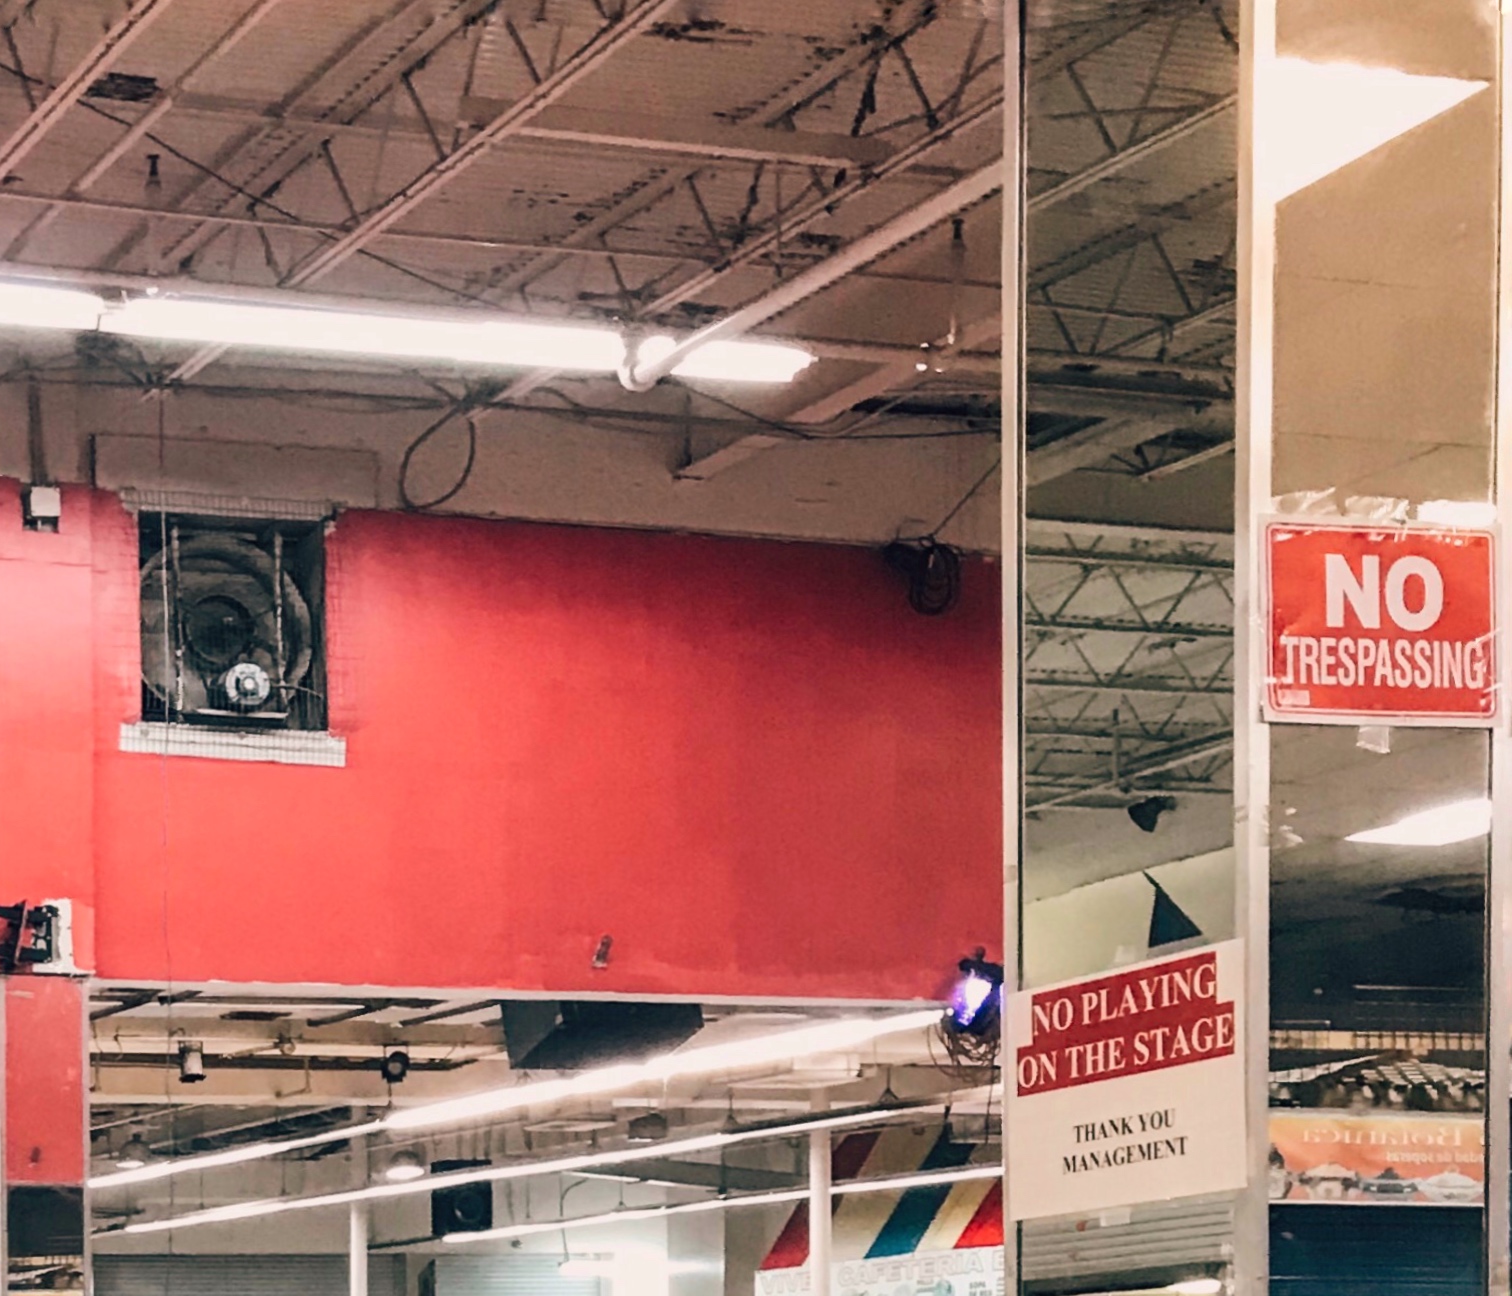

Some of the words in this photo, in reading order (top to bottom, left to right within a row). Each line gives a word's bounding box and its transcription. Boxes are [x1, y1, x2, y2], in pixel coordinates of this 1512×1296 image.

[1324, 552, 1444, 632] NO
[1280, 635, 1486, 689] TRESPASSING
[1032, 998, 1074, 1036] NO
[1081, 963, 1217, 1026] PLAYING
[1018, 1050, 1058, 1088] ON
[1065, 1037, 1127, 1079] THE
[1133, 1013, 1235, 1066] STAGE
[1073, 1116, 1134, 1144] THANK
[1138, 1108, 1176, 1132] YOU
[1062, 1136, 1189, 1175] MANAGEMENT
[837, 1251, 985, 1288] CAFETERIA
